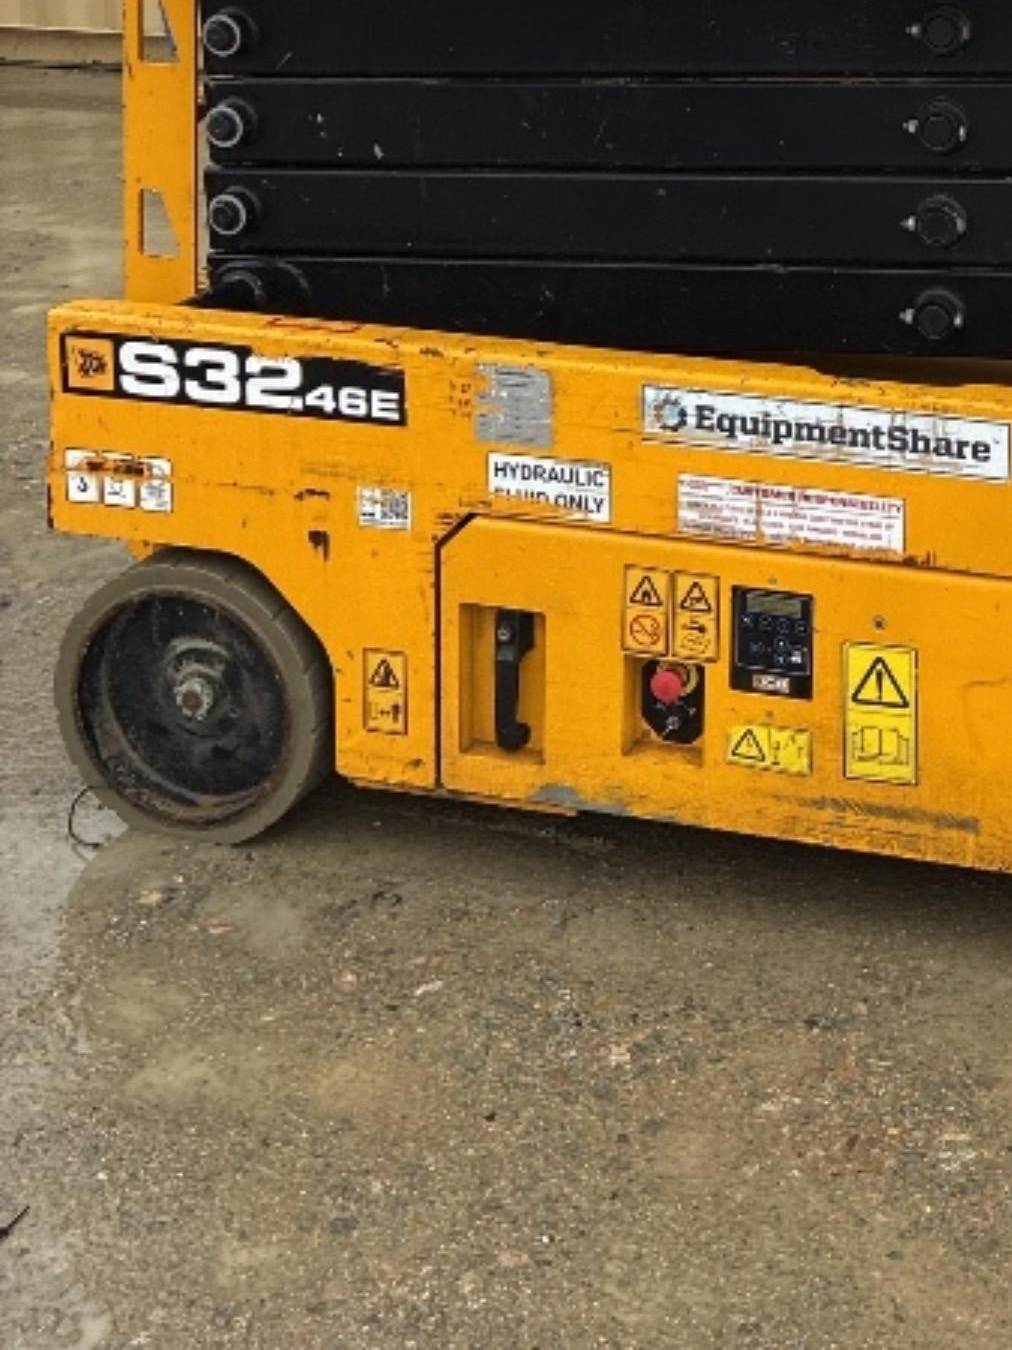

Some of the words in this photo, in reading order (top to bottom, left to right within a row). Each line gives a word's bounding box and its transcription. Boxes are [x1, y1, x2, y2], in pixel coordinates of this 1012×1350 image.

[695, 405, 991, 462] EquipmentShare
[494, 462, 604, 487] HYDRAULIC
[554, 494, 604, 514] ONLY
